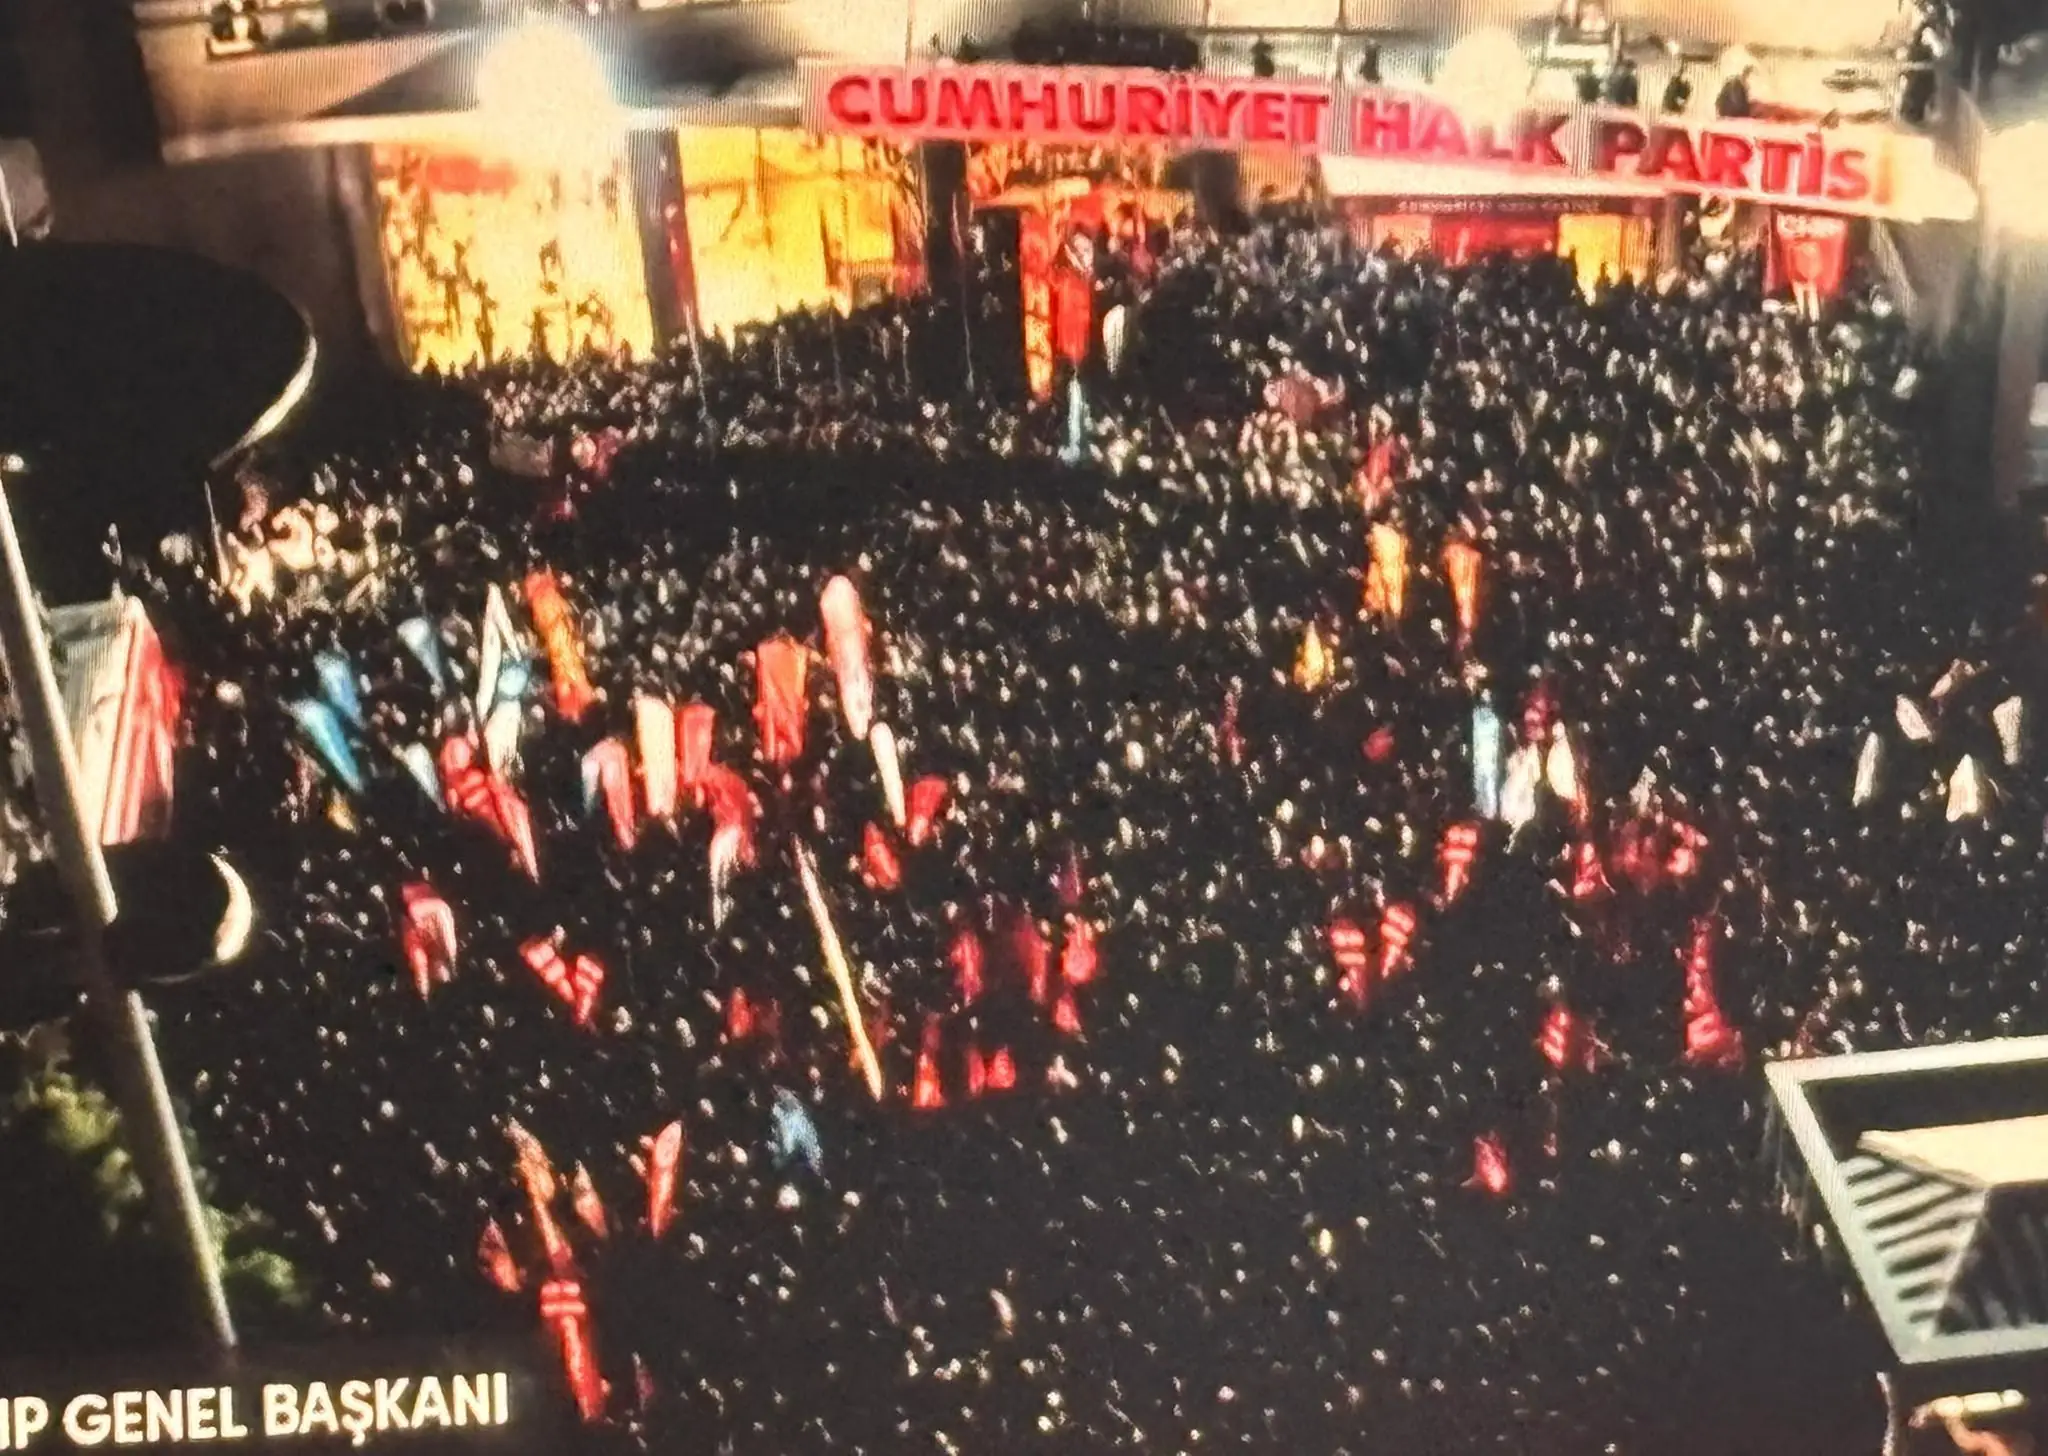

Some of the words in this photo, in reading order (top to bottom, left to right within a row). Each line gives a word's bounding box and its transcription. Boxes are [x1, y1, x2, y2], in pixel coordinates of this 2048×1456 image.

[828, 74, 1329, 142] CUMHURİYET
[1360, 98, 1569, 166] HALK
[62, 1386, 248, 1445] GENEL
[263, 1372, 508, 1446] BAŞKANI
